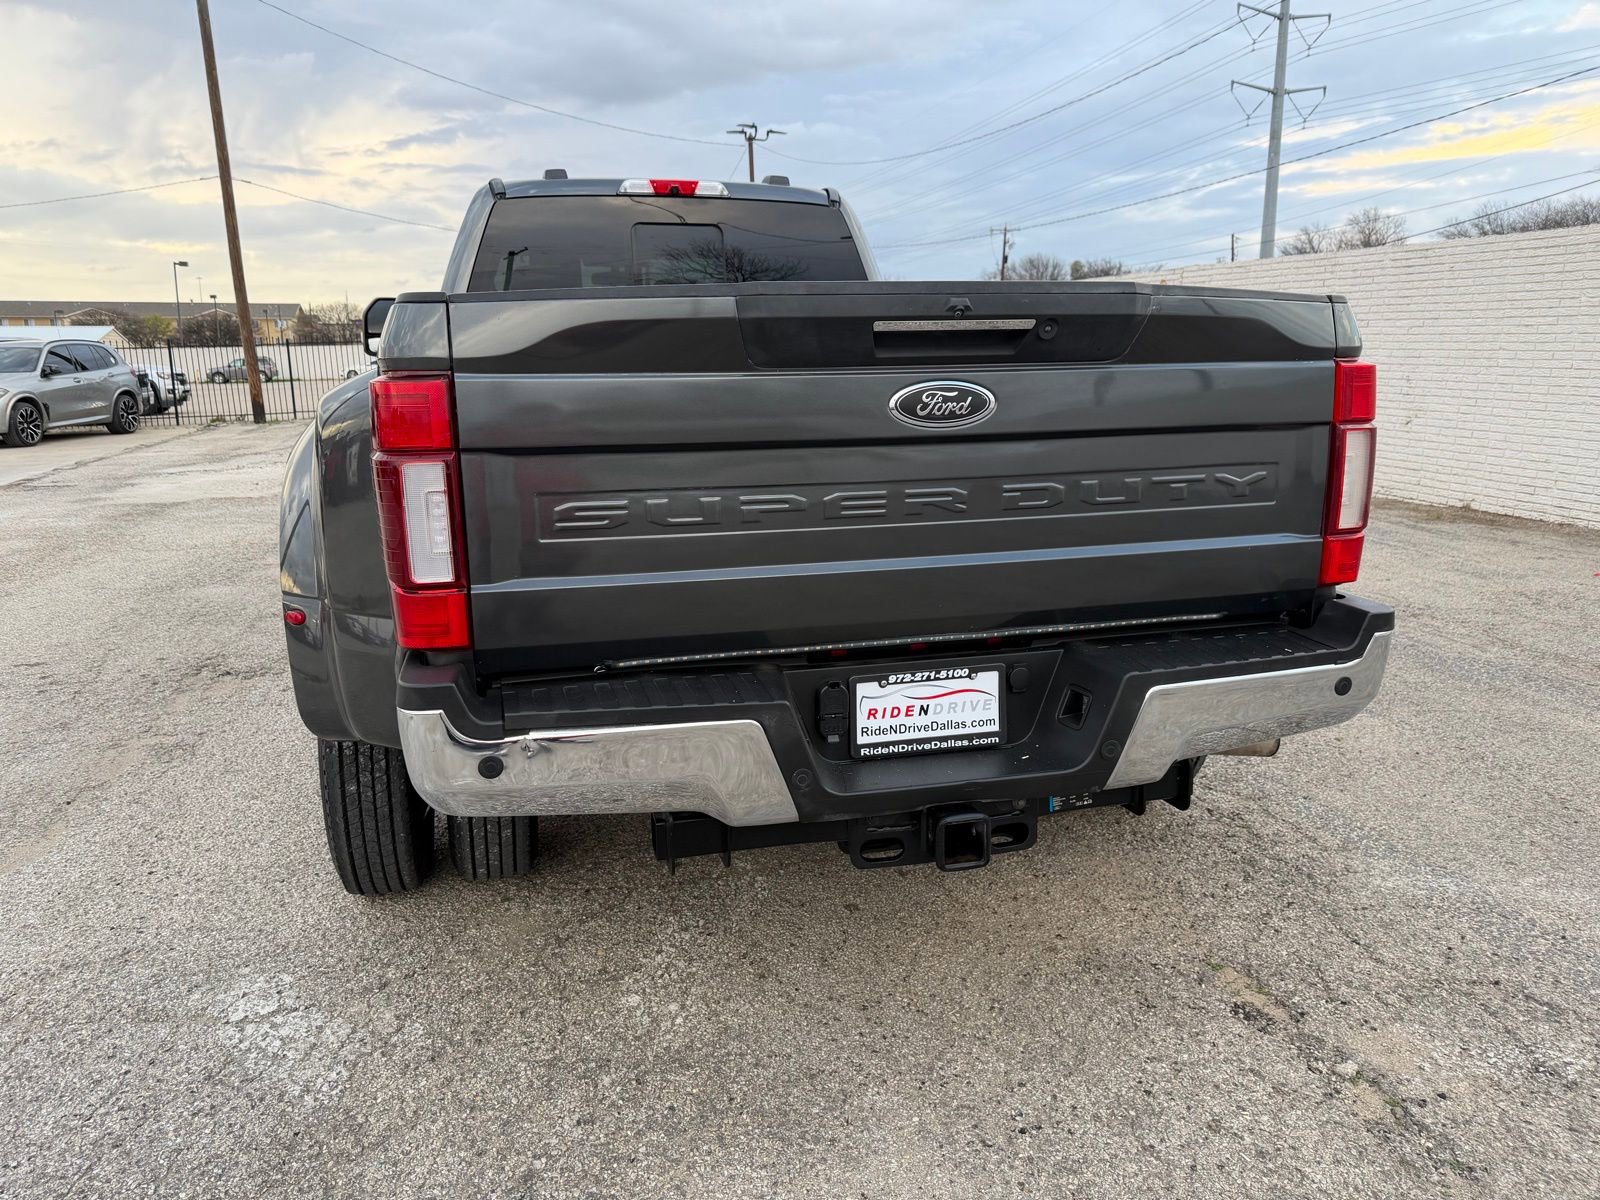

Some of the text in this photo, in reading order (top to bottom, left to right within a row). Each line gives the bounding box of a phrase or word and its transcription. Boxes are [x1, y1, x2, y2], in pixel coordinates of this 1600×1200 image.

[916, 390, 972, 416] Ford
[554, 471, 1267, 530] SUPER DUTY
[888, 668, 969, 684] 972-271-5100
[861, 718, 996, 737] RideNDriveDallas.com
[860, 736, 999, 756] RideNDriveDallas.com
